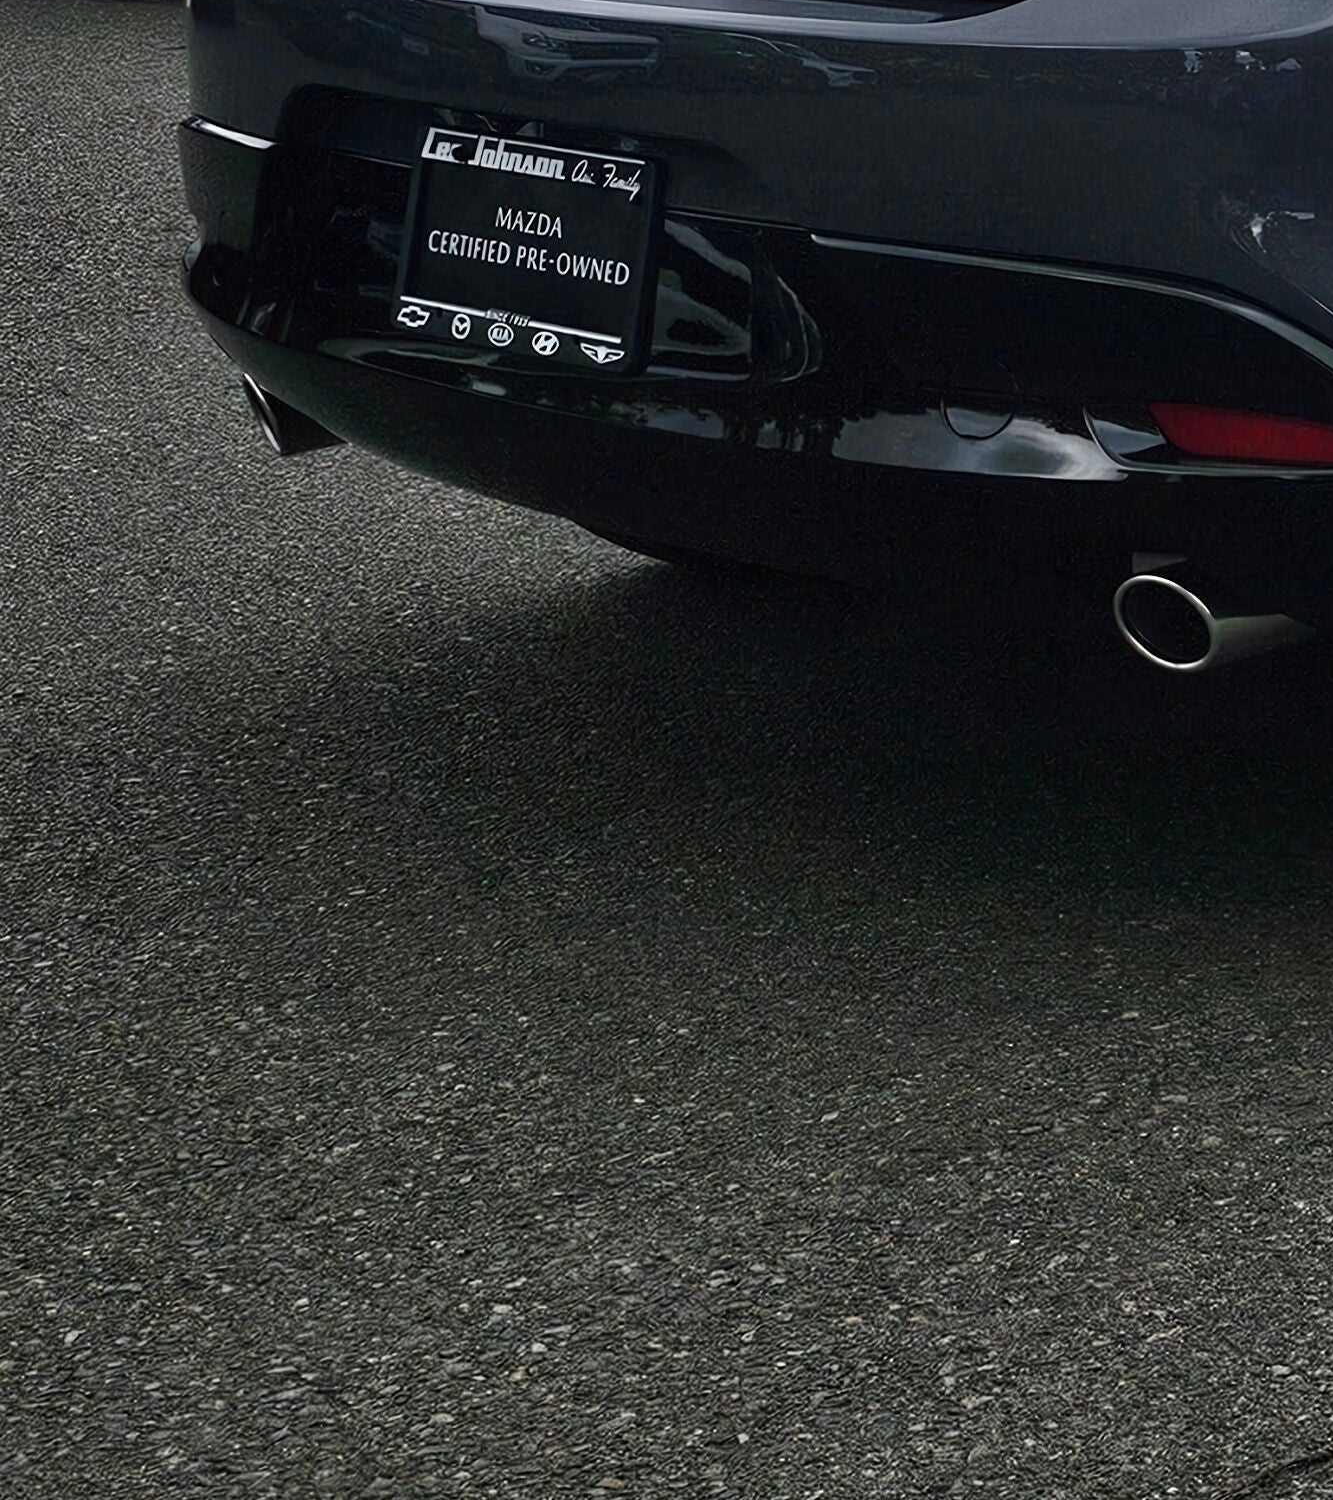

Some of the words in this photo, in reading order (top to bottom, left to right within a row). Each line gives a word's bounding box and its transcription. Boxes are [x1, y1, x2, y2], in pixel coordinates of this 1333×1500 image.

[468, 135, 566, 180] Johnson
[495, 206, 563, 239] MAZDA
[428, 229, 510, 265] CERTIFIED
[516, 246, 630, 286] PRE-OWNED
